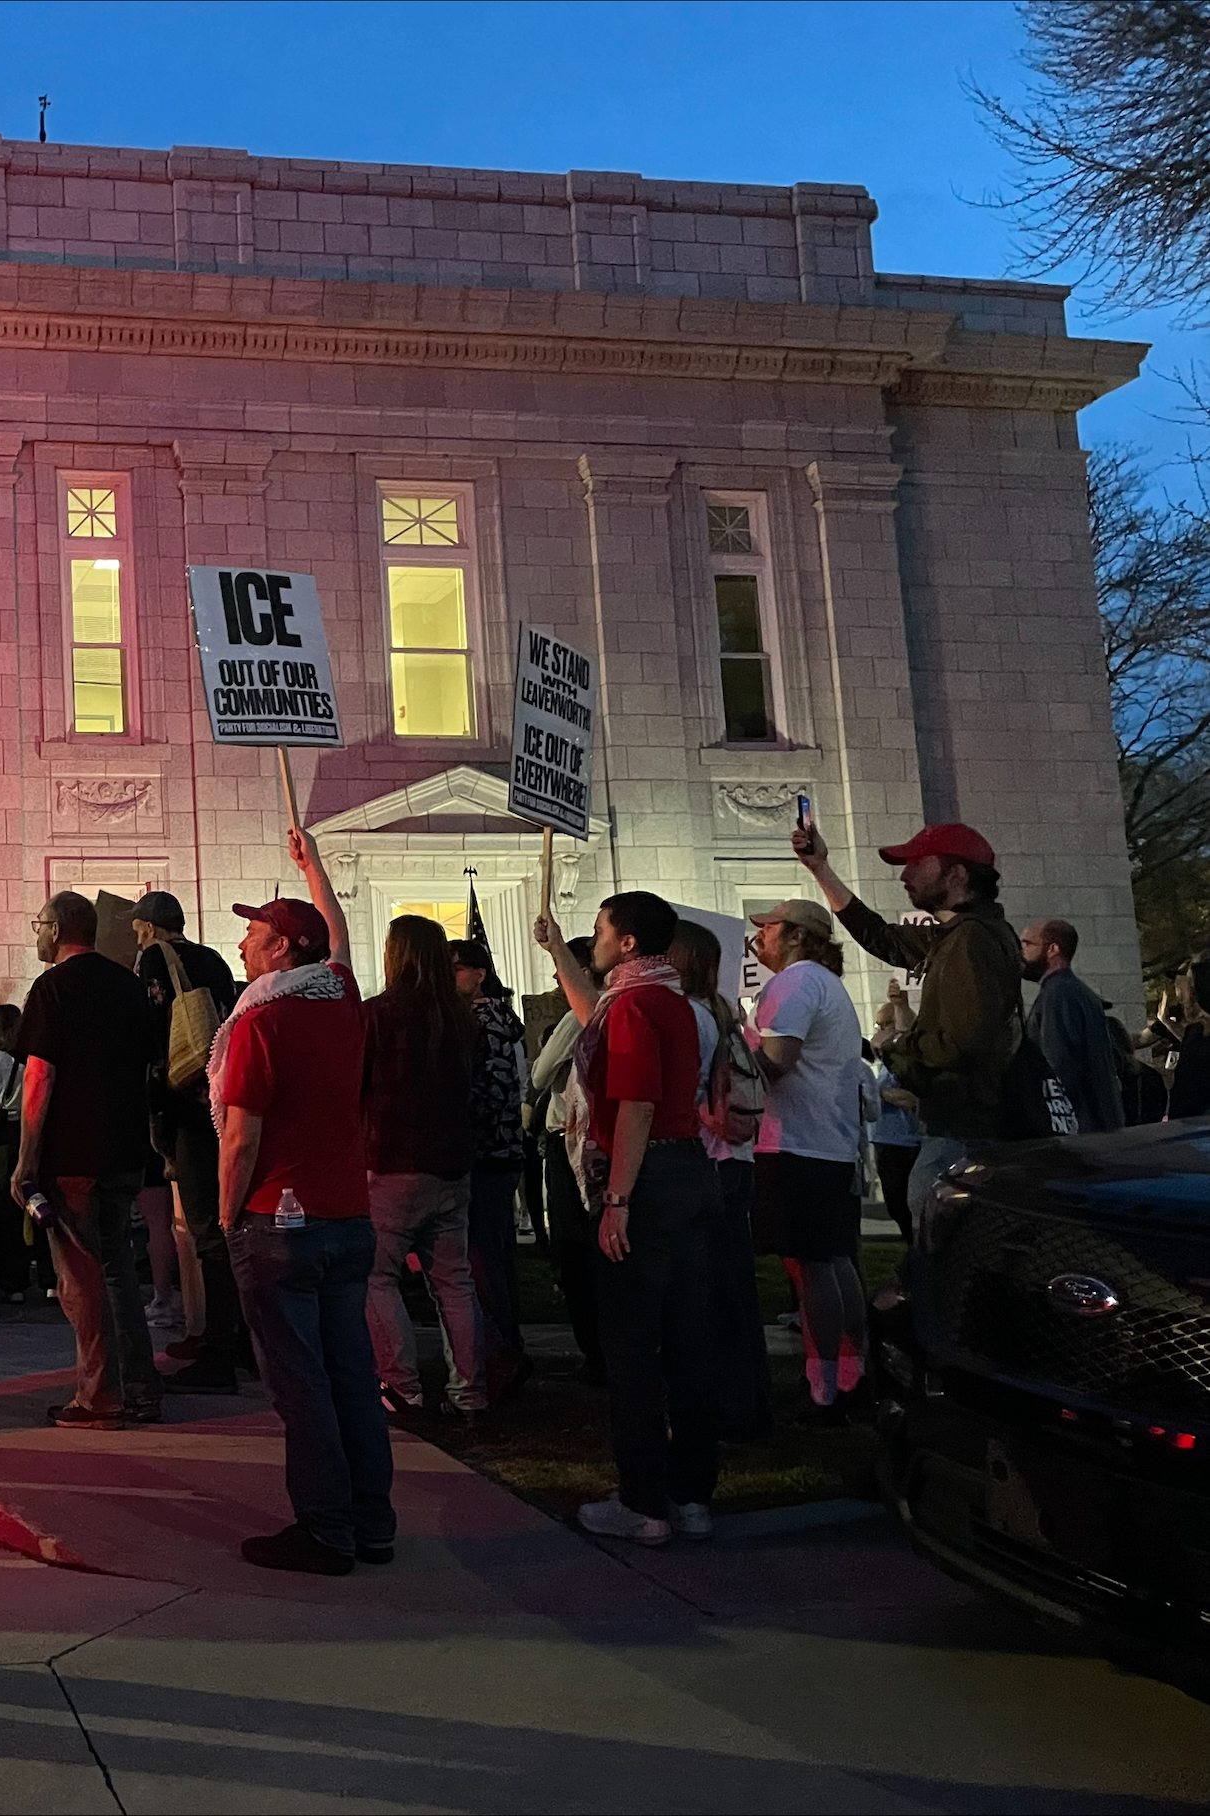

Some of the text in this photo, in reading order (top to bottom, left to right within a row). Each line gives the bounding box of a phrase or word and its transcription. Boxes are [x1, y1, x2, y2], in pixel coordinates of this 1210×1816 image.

[218, 572, 302, 647] ICE
[218, 659, 319, 689] OUT OF OUR
[529, 630, 590, 691] WE STAND
[213, 688, 334, 720] COMMUNITIES
[541, 671, 577, 699] WITH
[523, 723, 584, 776] ICE OUT OF
